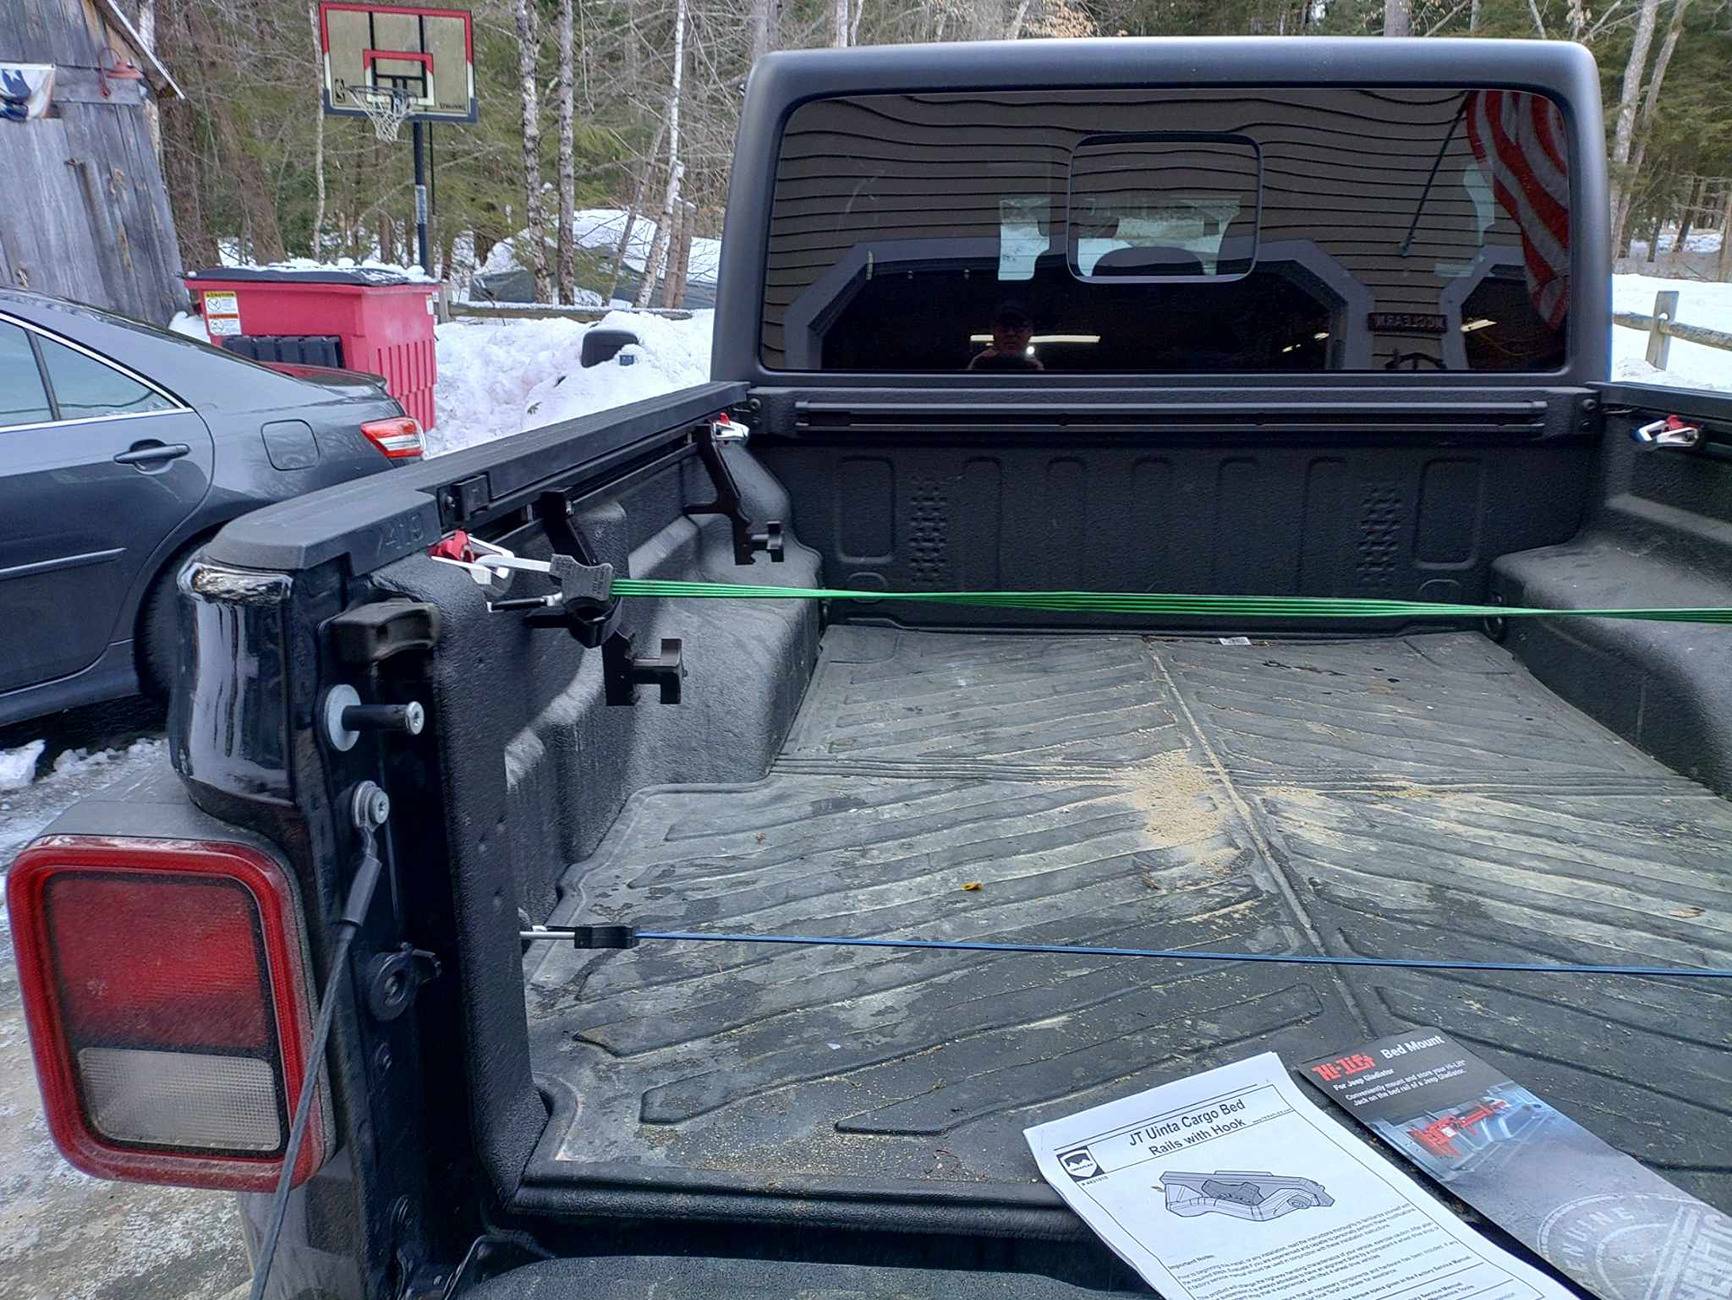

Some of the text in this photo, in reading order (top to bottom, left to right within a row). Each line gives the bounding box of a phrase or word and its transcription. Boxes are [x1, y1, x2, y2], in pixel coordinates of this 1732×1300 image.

[1380, 1035, 1446, 1060] Bed Mount
[1332, 1068, 1395, 1092] For Jeep Gladiator
[1129, 1098, 1246, 1146] JT Uinta Cargo Bed
[1148, 1118, 1247, 1156] Rails with Hook
